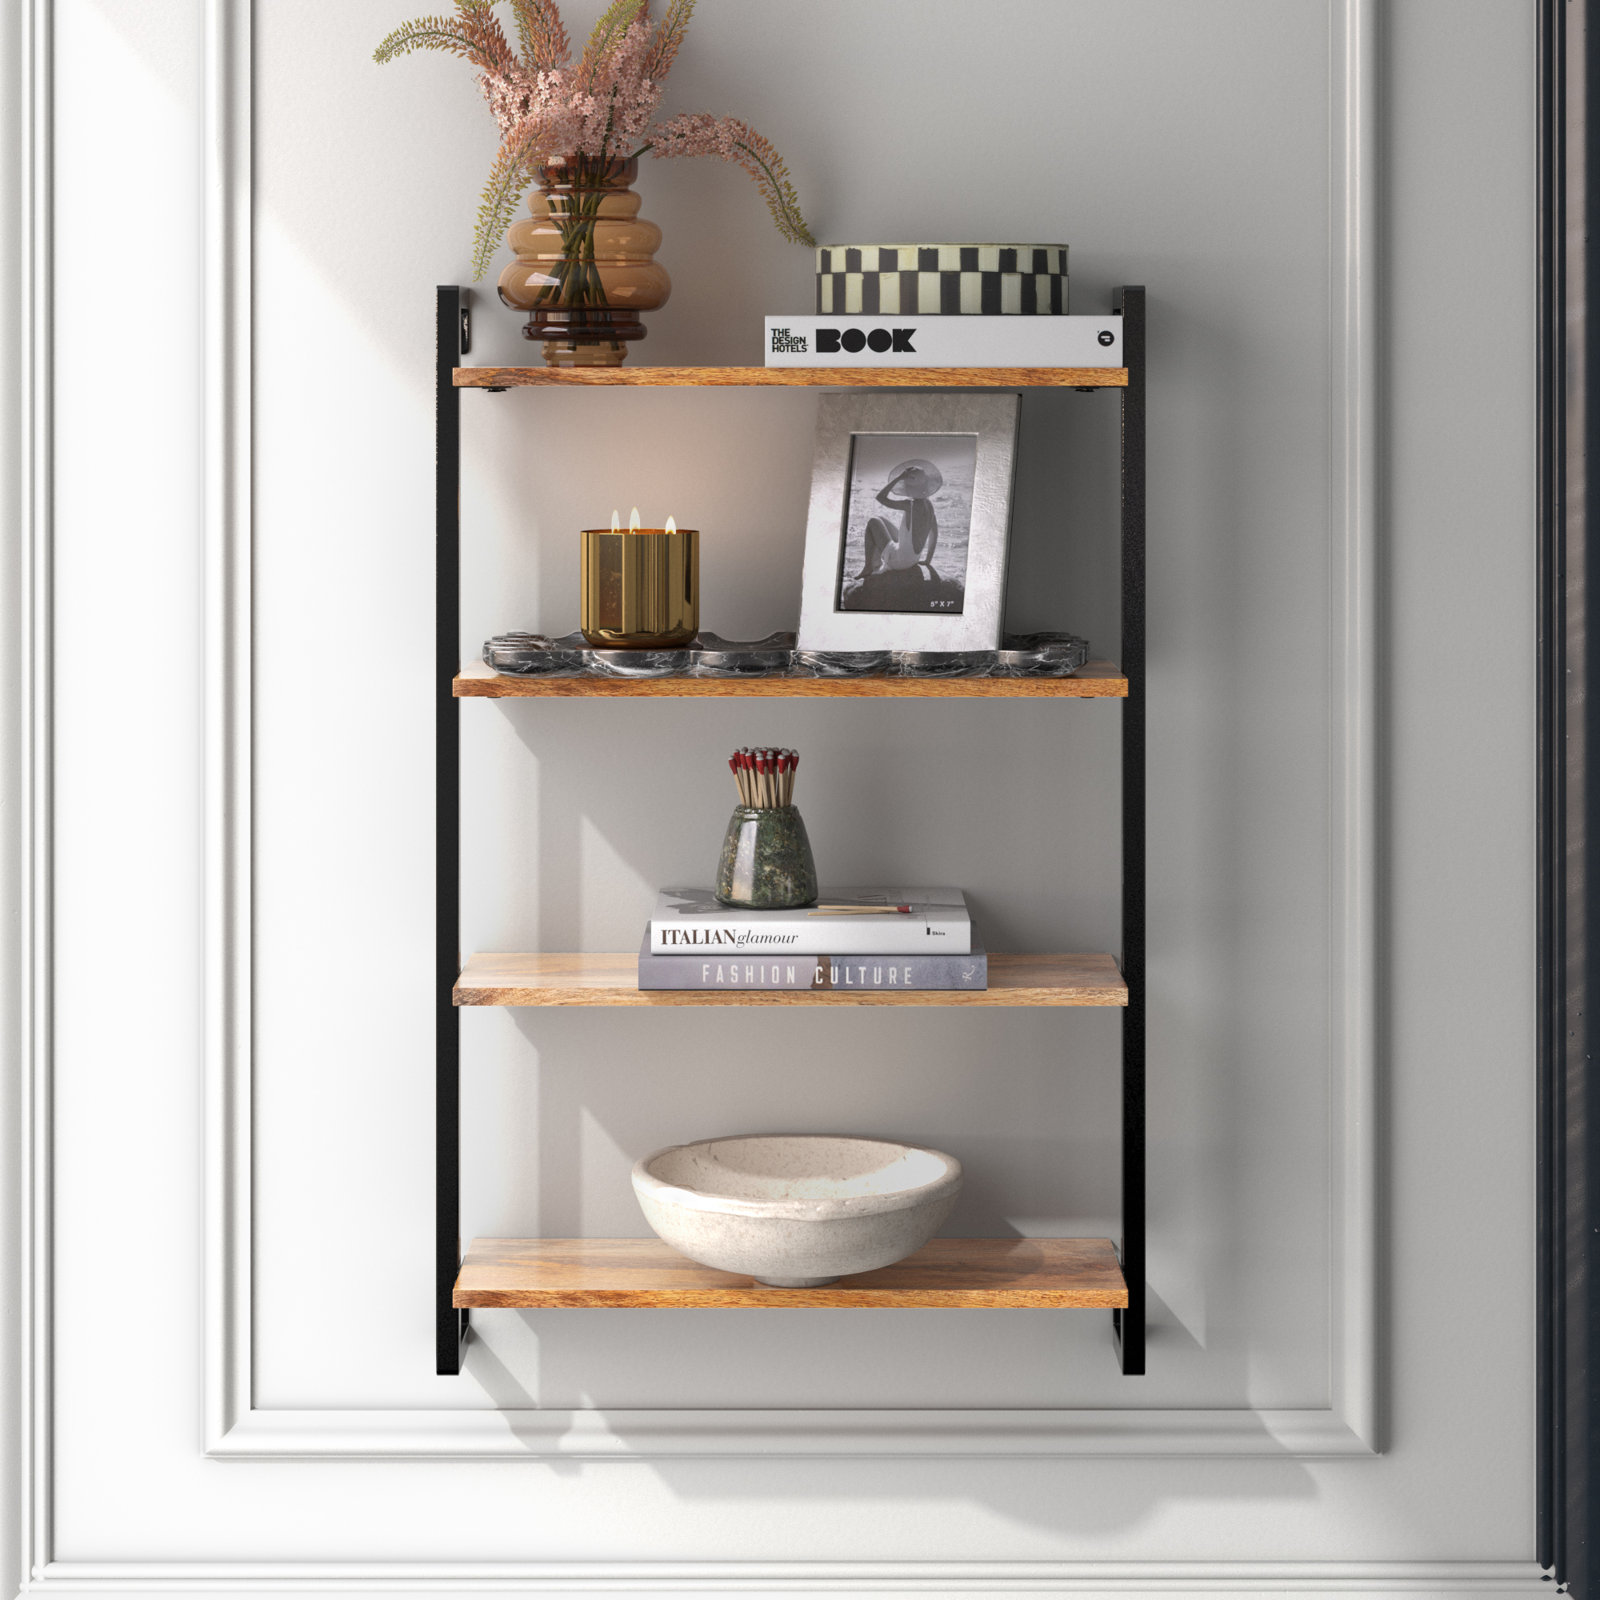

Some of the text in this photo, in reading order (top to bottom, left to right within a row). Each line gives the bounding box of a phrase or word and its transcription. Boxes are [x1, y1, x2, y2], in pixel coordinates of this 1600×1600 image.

[771, 328, 791, 337] THE
[771, 336, 807, 345] DESIGN
[815, 328, 917, 353] BOOK
[771, 344, 808, 353] HOTELS
[702, 964, 912, 985] FASHION CULTURE
